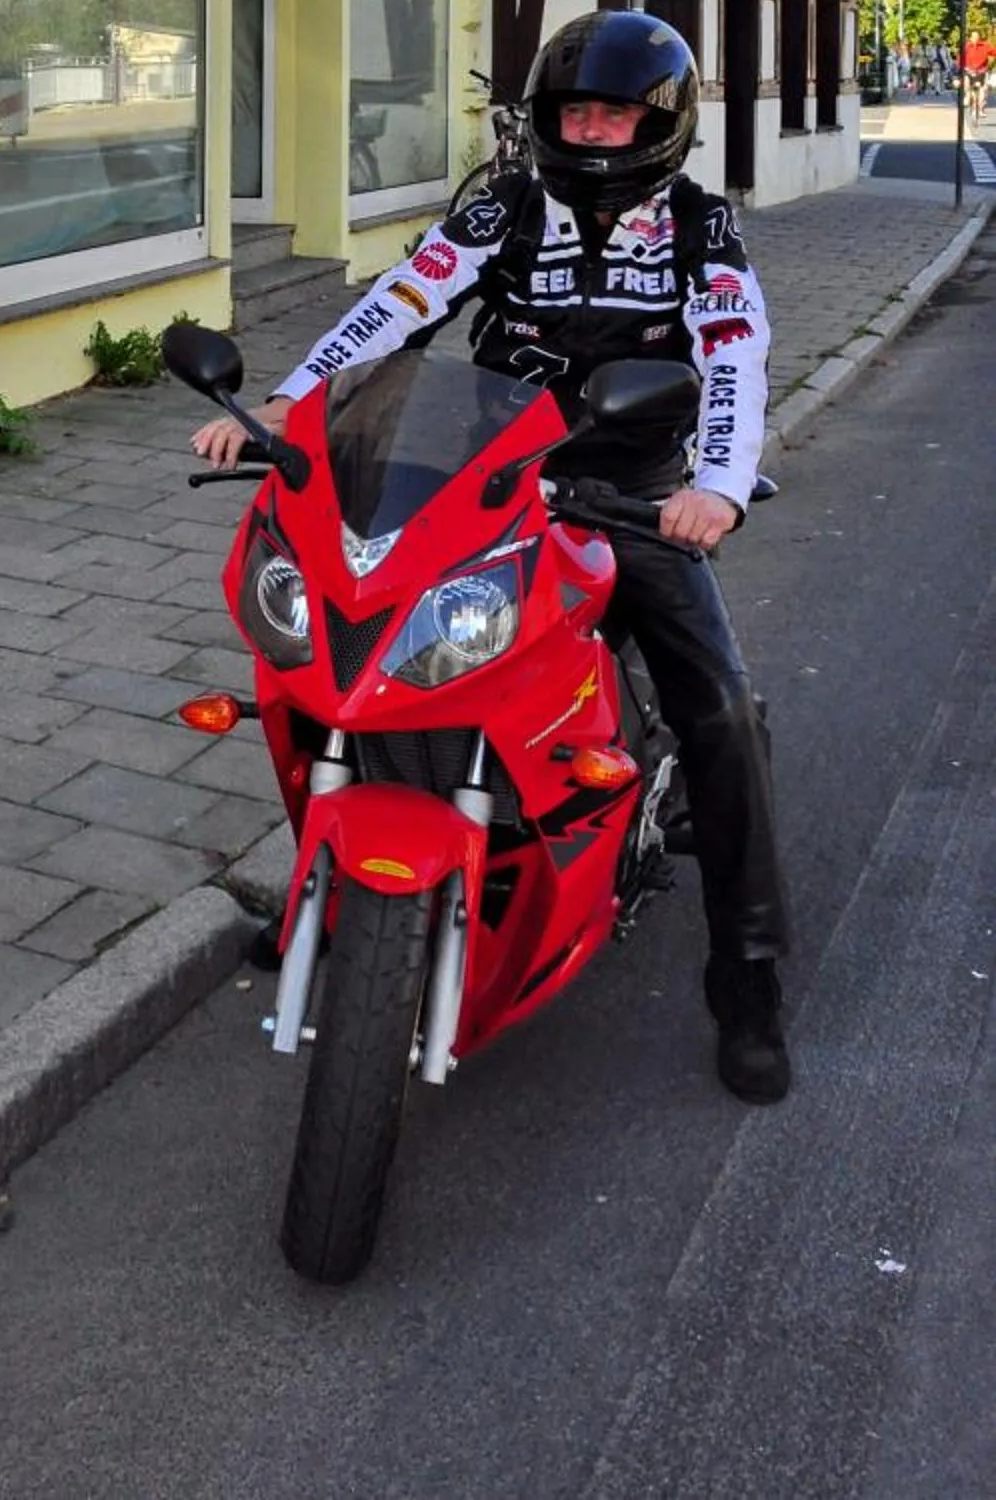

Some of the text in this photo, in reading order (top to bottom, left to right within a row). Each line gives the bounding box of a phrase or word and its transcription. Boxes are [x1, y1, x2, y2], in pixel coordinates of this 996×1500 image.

[306, 341, 353, 380] RACE
[340, 300, 394, 349] TRACK
[708, 364, 738, 410] RACE
